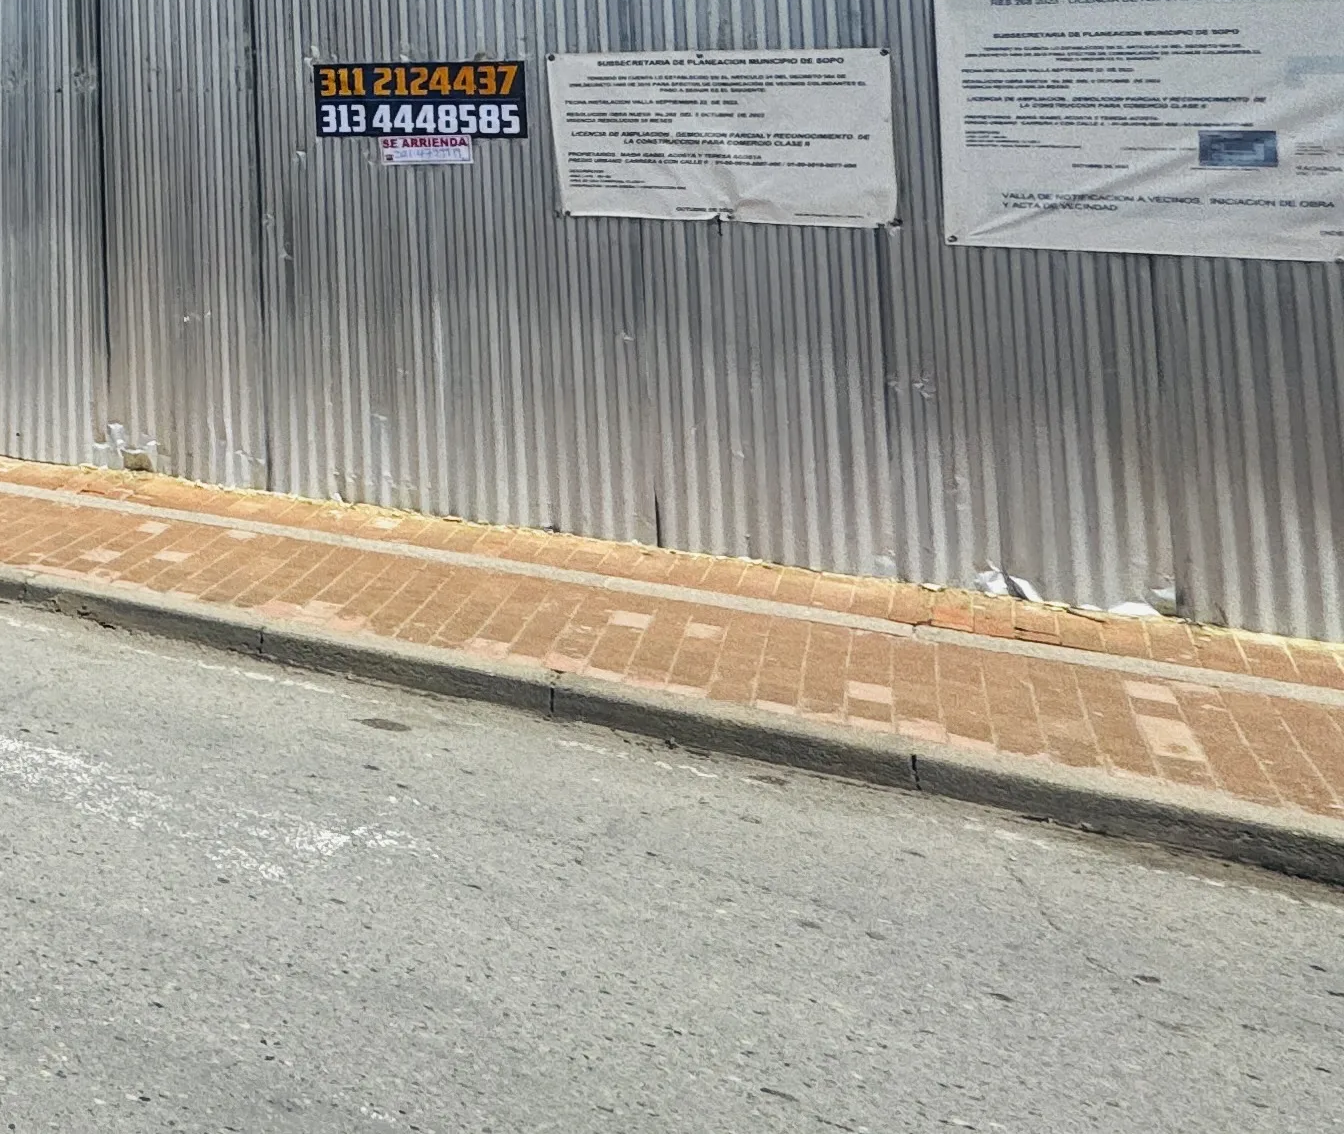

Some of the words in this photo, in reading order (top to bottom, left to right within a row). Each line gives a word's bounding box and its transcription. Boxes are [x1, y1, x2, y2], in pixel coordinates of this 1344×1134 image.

[686, 58, 746, 66] PLANEACION
[319, 67, 365, 96] 311
[373, 65, 518, 96] 2124437
[320, 104, 366, 133] 313
[372, 104, 520, 134] 4448585
[383, 138, 397, 148] SE
[402, 137, 468, 148] ARRIENDA
[1001, 192, 1036, 201] VALLA
[1037, 192, 1054, 200] DE
[1137, 195, 1148, 204] A
[1279, 199, 1297, 208] DE
[1298, 199, 1335, 209] OBRA
[1002, 201, 1009, 209] Y
[1012, 201, 1042, 209] ACTA
